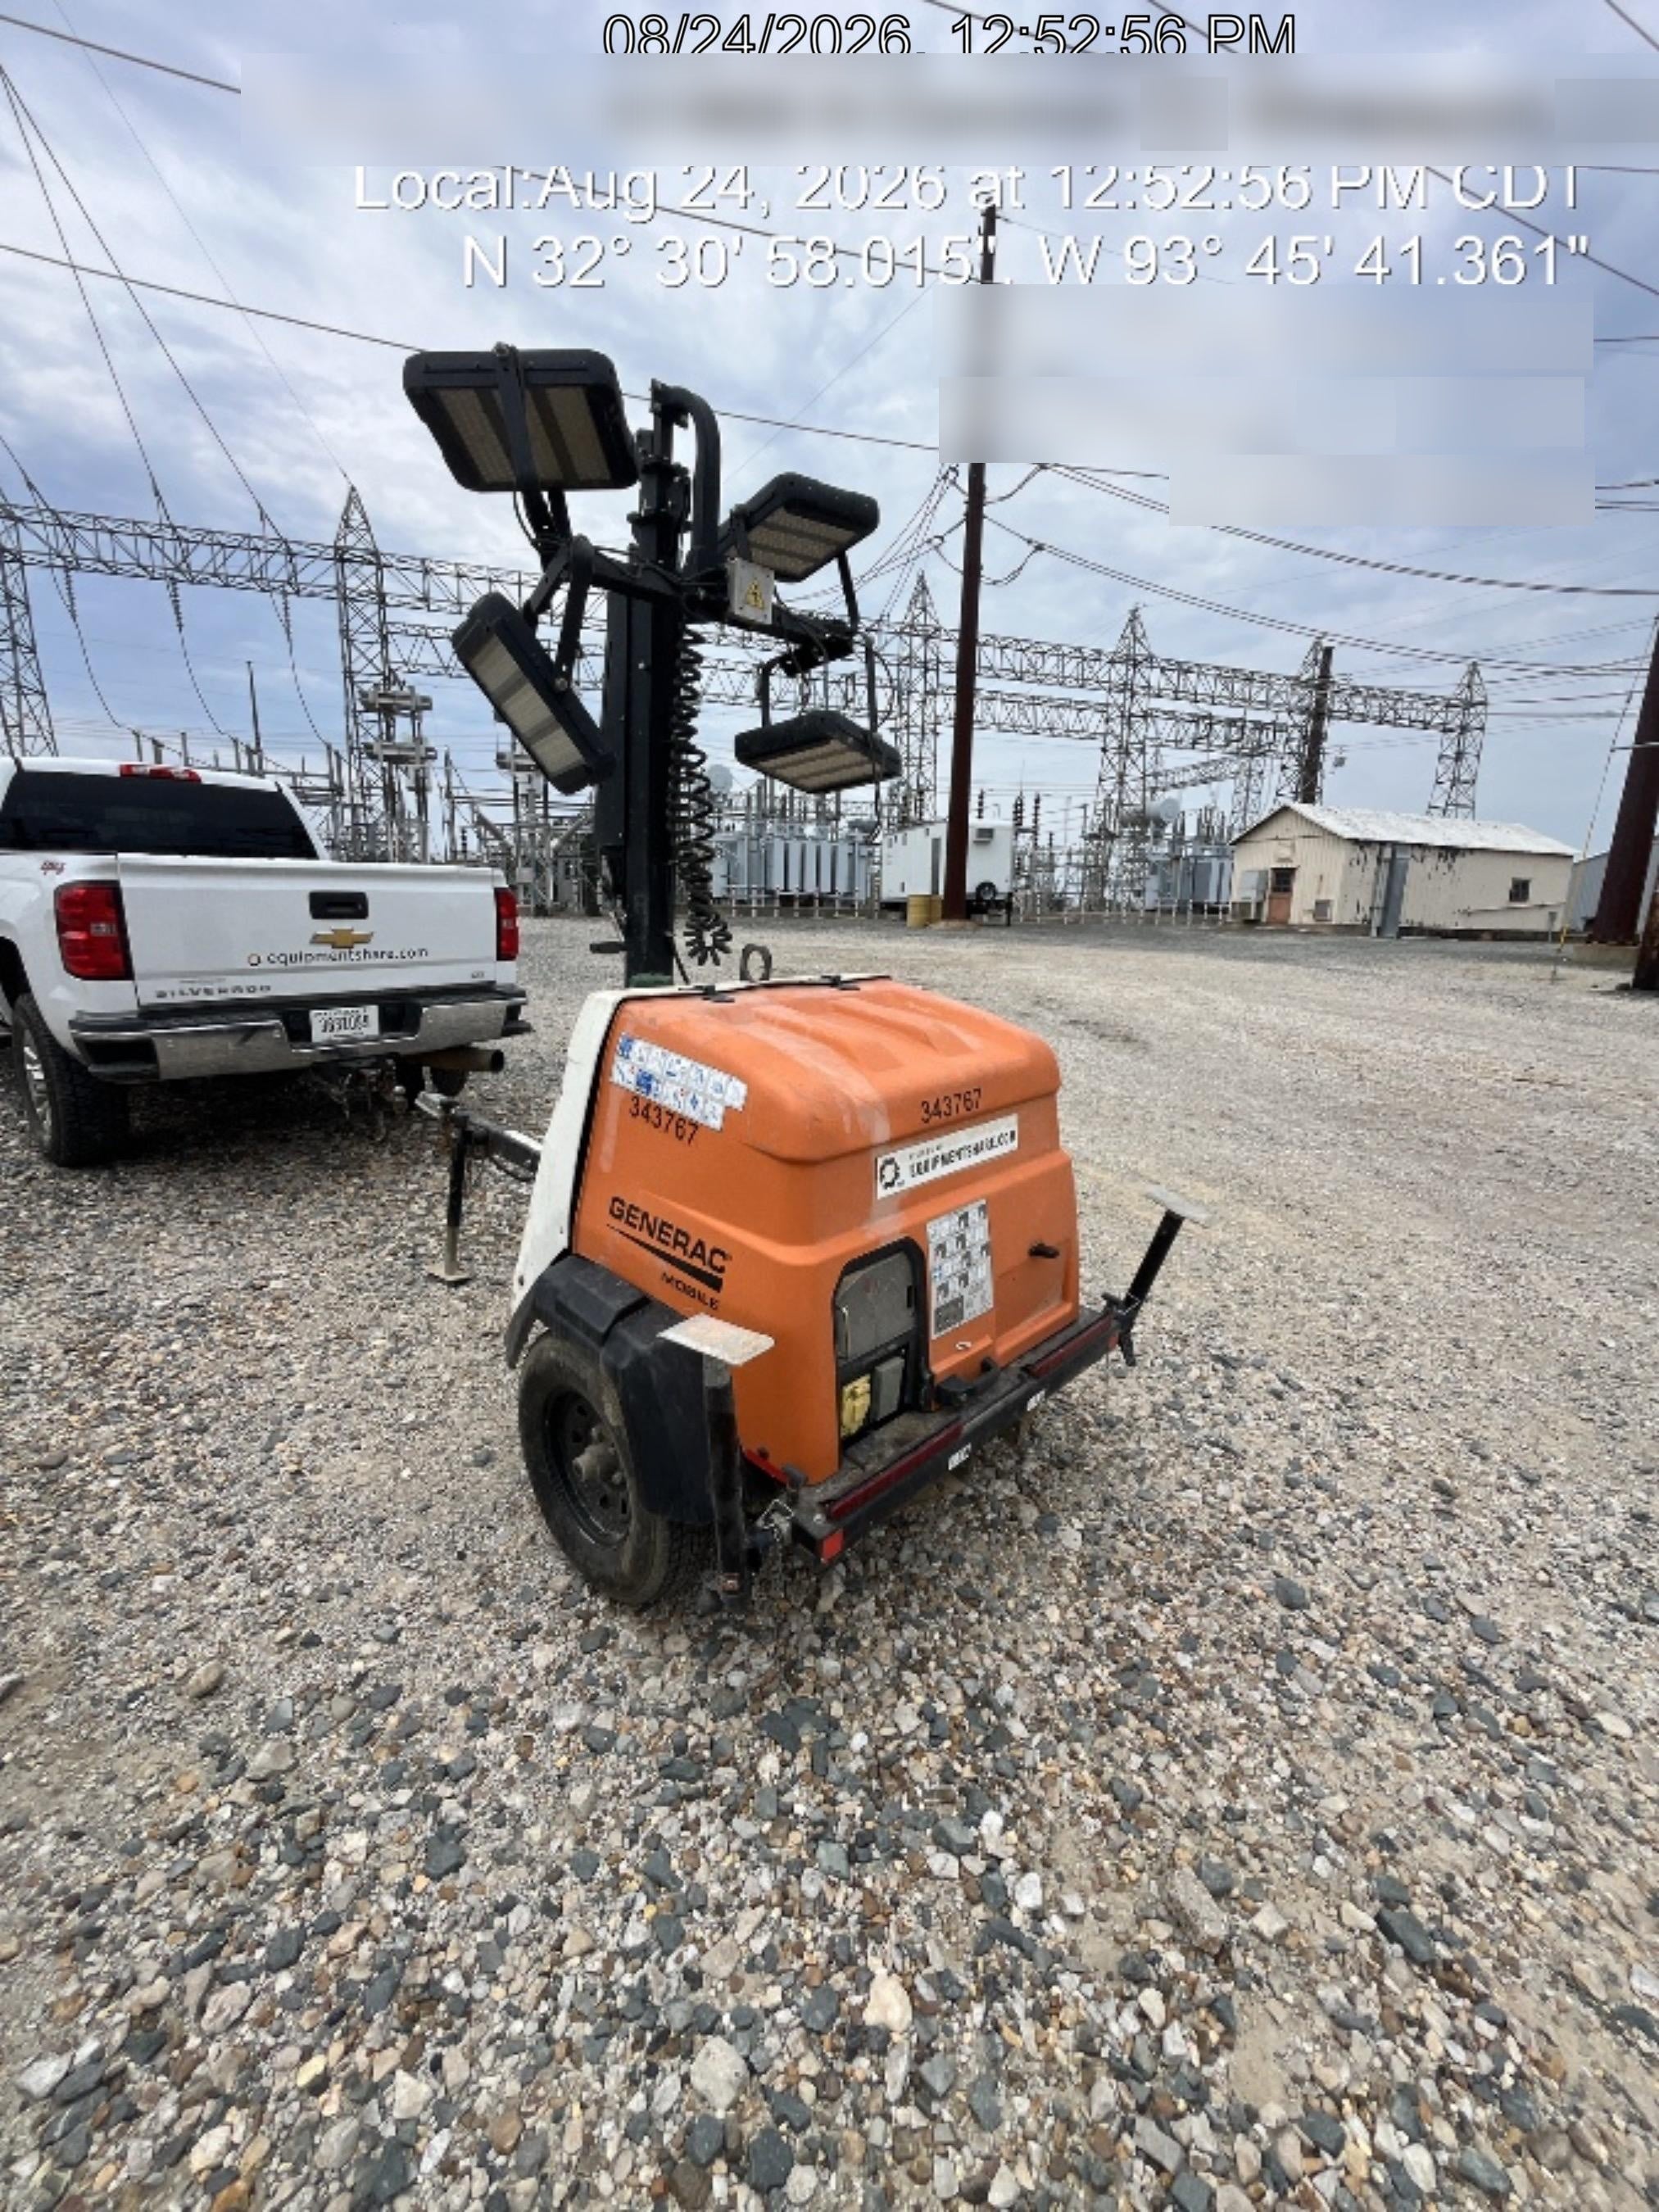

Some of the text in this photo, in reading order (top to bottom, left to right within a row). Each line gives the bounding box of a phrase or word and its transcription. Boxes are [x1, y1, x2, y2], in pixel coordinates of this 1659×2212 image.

[267, 946, 428, 966] equipmentshare.com
[629, 1095, 699, 1145] 343767
[921, 1088, 981, 1123] 343767
[609, 1196, 727, 1274] GENERAC
[661, 1272, 719, 1311] MOBILE
